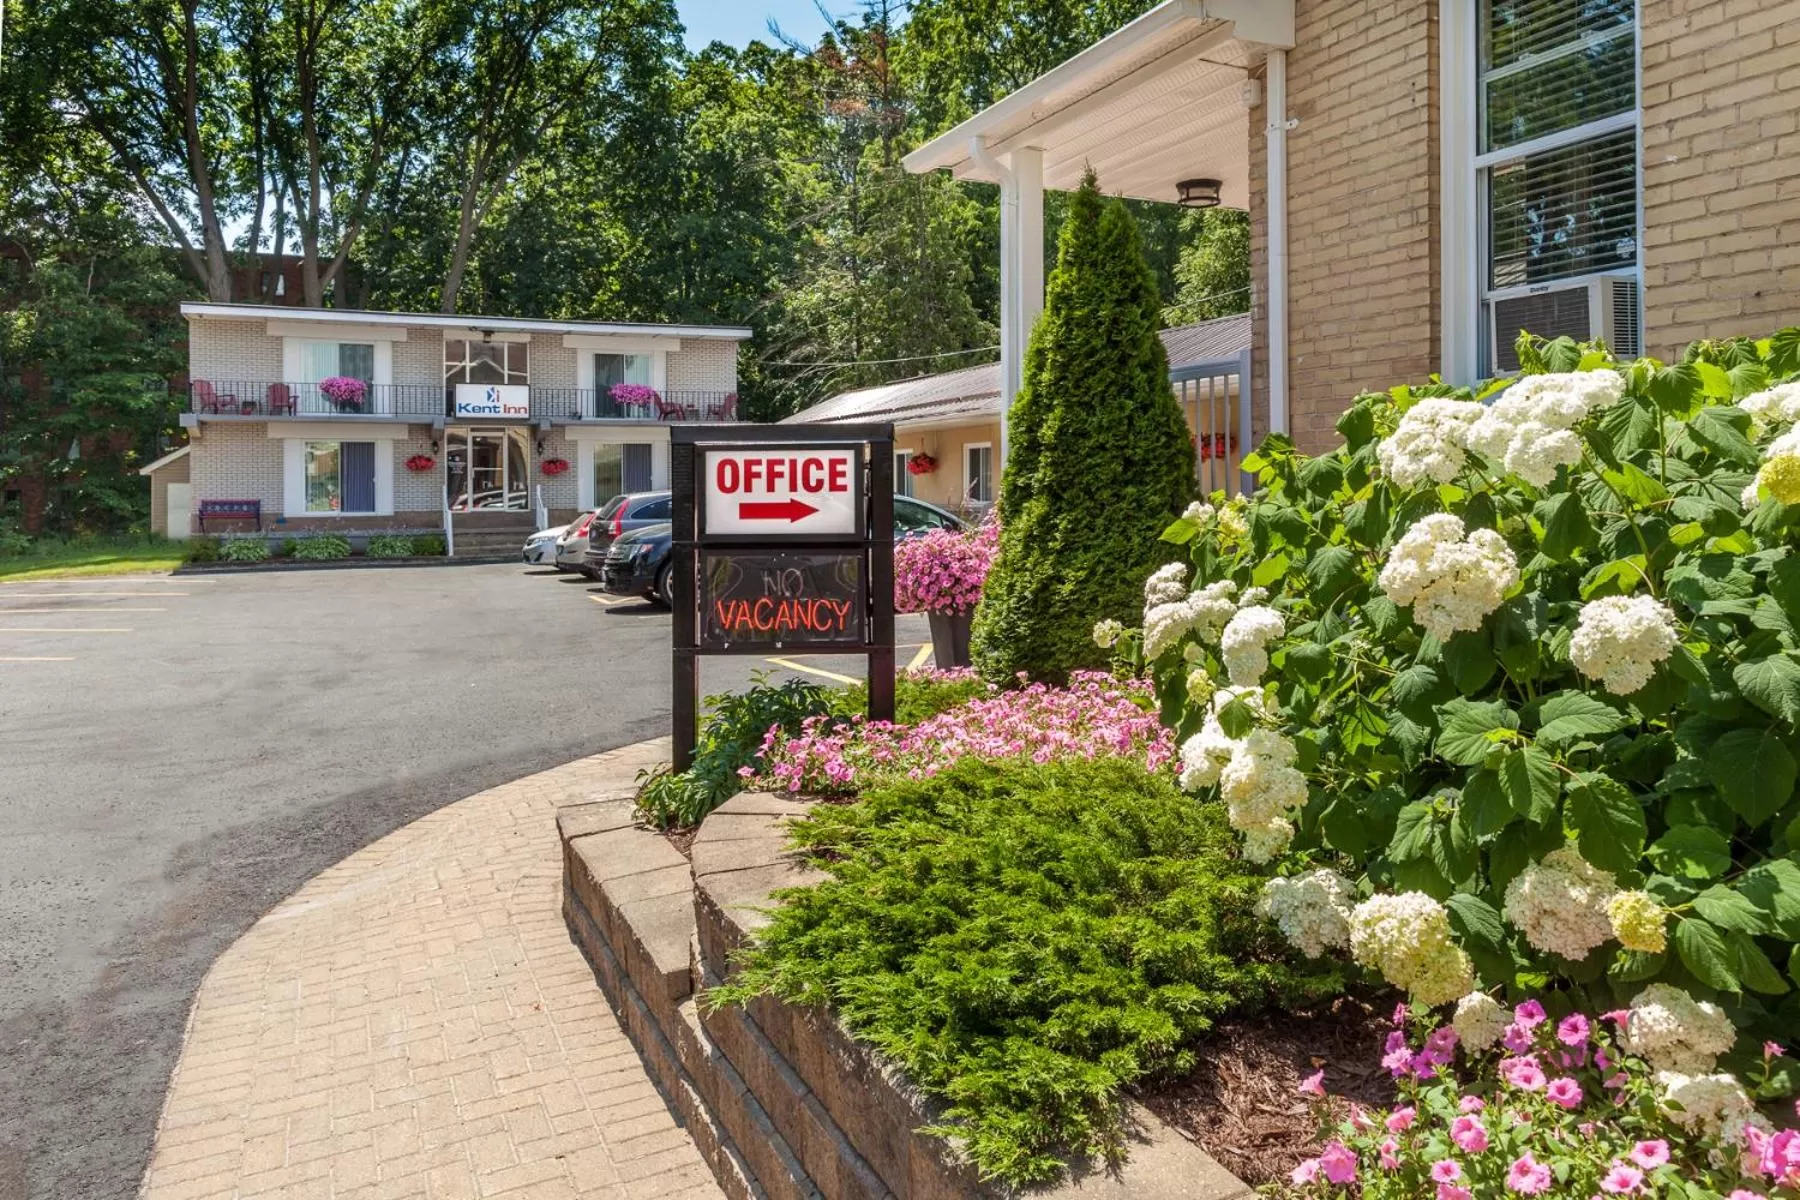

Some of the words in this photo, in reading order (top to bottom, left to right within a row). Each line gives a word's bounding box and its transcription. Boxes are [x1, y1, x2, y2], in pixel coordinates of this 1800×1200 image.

[458, 403, 500, 414] Kent
[503, 404, 528, 414] Inn
[716, 457, 848, 494] OFFICE
[764, 568, 804, 597] NO
[716, 597, 851, 632] VACANCY
